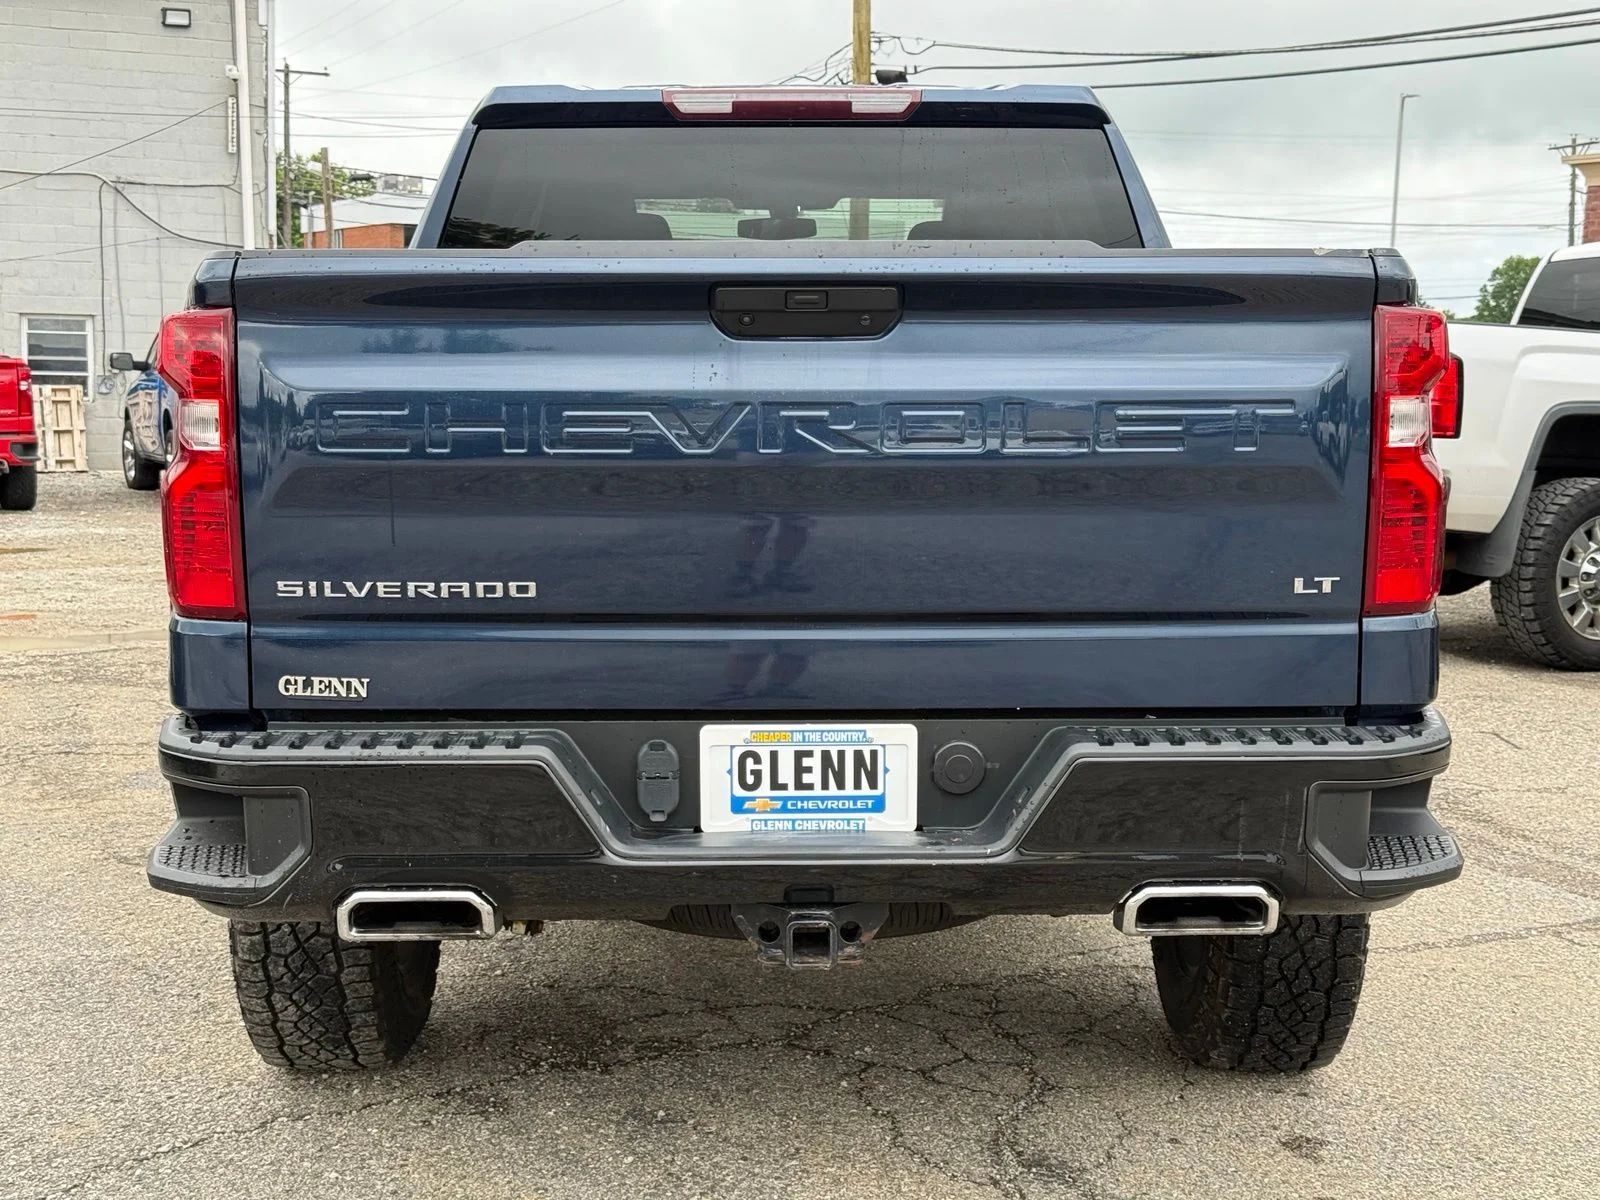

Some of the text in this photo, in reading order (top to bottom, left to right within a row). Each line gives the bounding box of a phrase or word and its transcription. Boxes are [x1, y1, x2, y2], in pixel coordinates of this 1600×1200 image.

[315, 402, 1297, 456] CHEVROLET
[276, 580, 537, 599] SILVERADO
[1294, 577, 1340, 594] LT
[277, 674, 371, 699] GLENN
[750, 731, 792, 743] CHEAPER
[793, 731, 803, 743] IN
[804, 731, 821, 743] THE
[737, 749, 879, 792] GLENN
[787, 799, 875, 810] CHEVROLET
[752, 819, 865, 831] GLENN CHEVROLET
